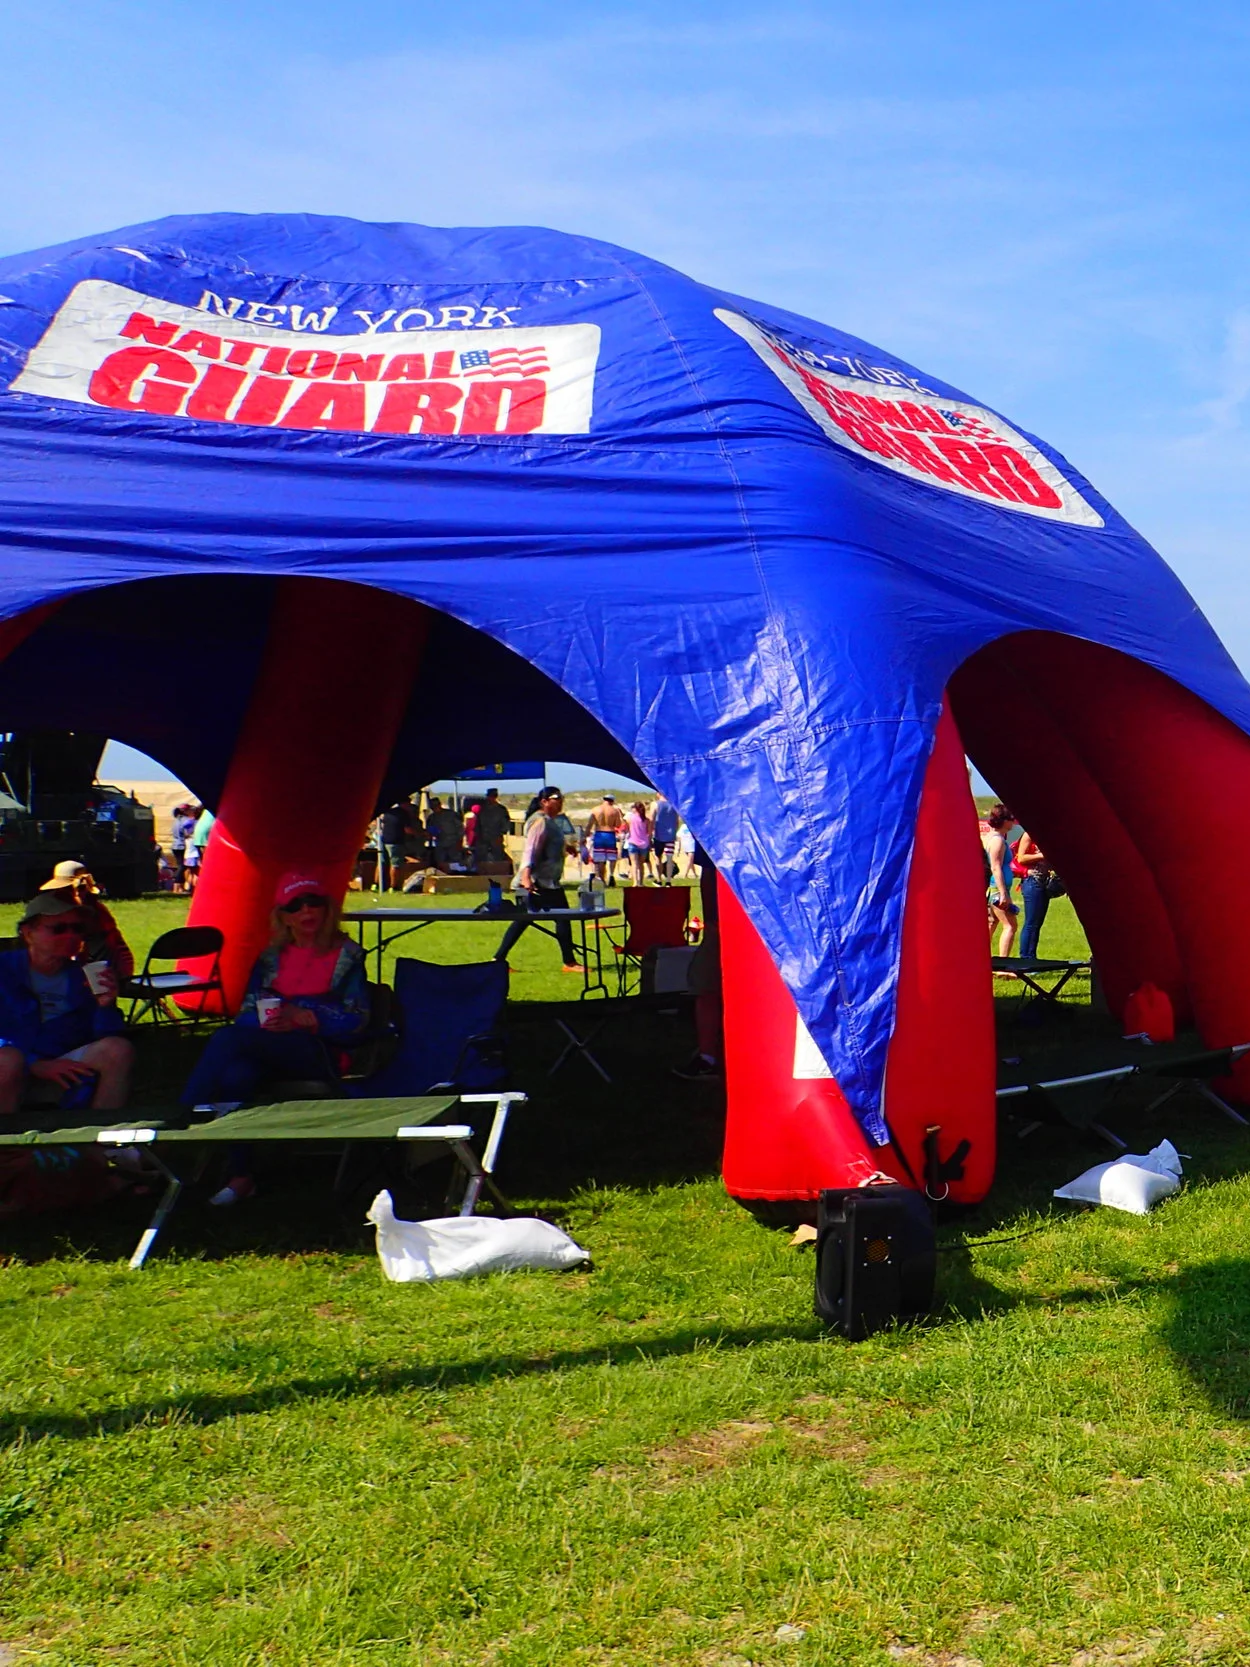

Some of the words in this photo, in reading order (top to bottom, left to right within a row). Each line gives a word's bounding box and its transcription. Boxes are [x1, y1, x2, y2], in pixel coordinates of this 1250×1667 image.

[196, 289, 340, 332] NEW
[354, 305, 522, 334] YORK
[118, 312, 462, 382] NATIONAL
[88, 345, 548, 435] GUARD
